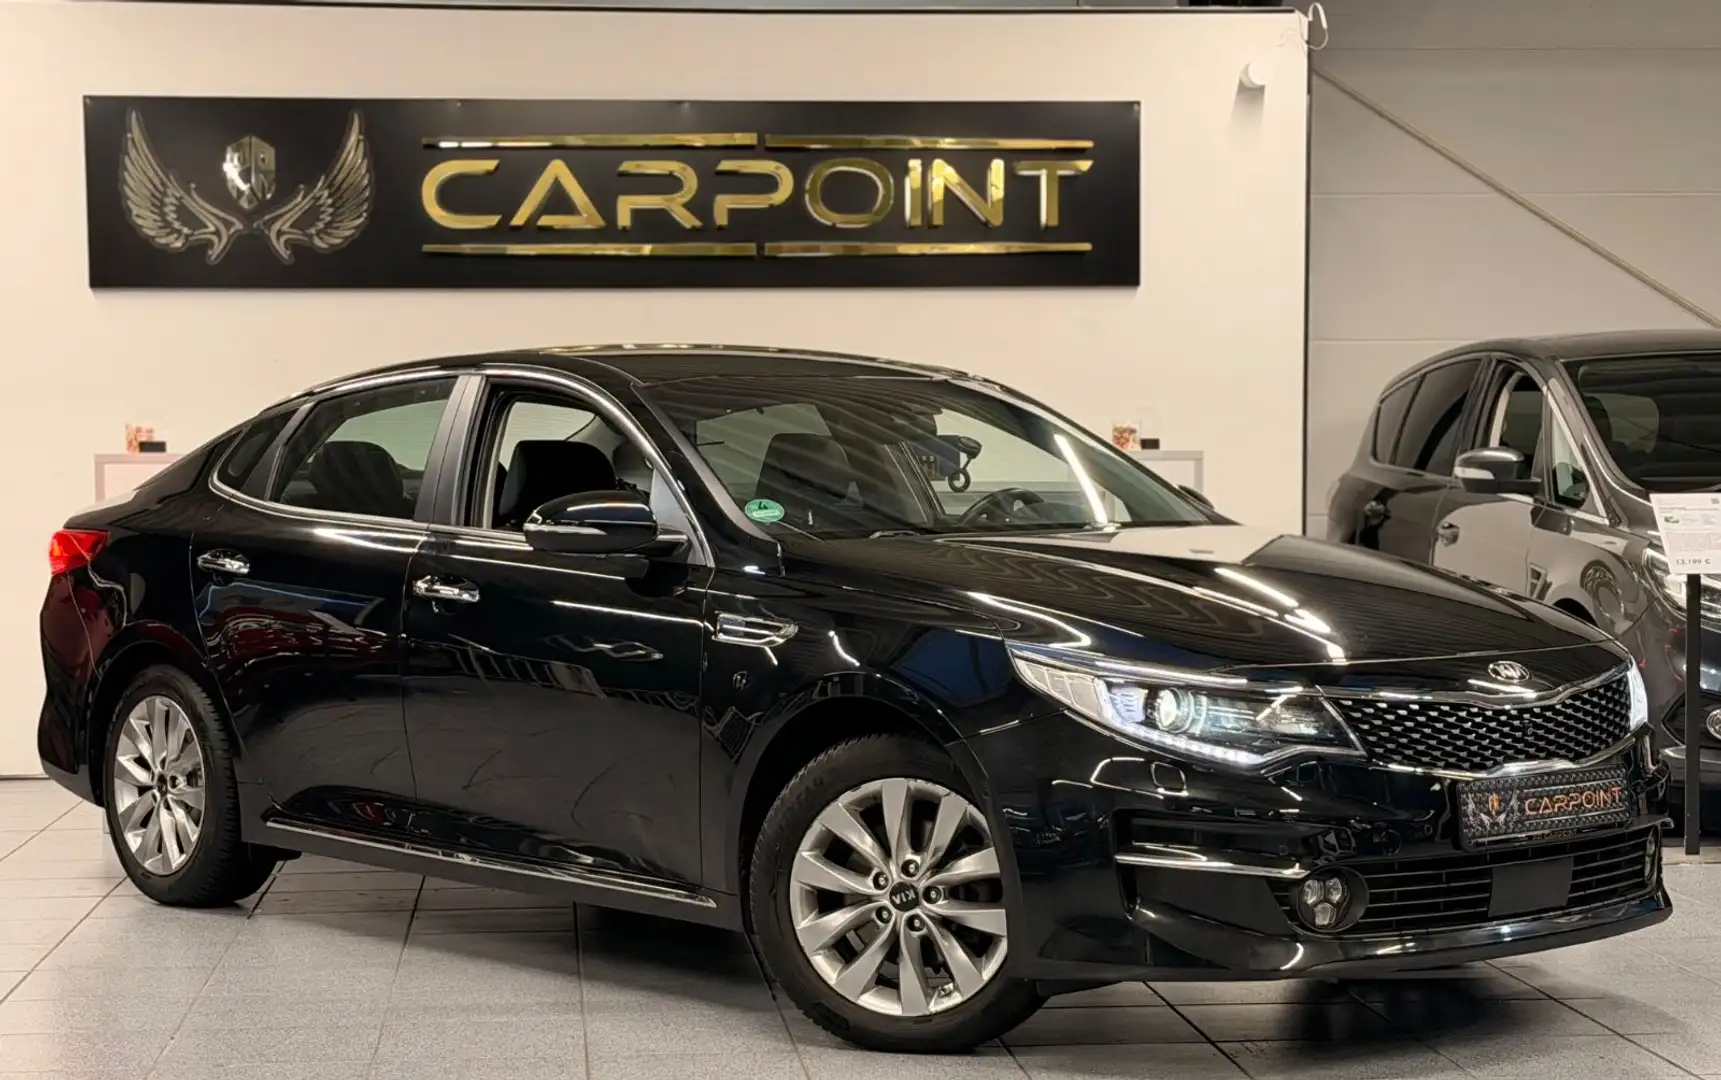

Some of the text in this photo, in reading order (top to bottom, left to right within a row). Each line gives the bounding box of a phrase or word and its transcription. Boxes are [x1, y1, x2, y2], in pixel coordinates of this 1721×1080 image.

[421, 157, 1095, 230] CARPOINT
[1525, 786, 1622, 815] CARPOINT
[892, 889, 916, 904] KIA
